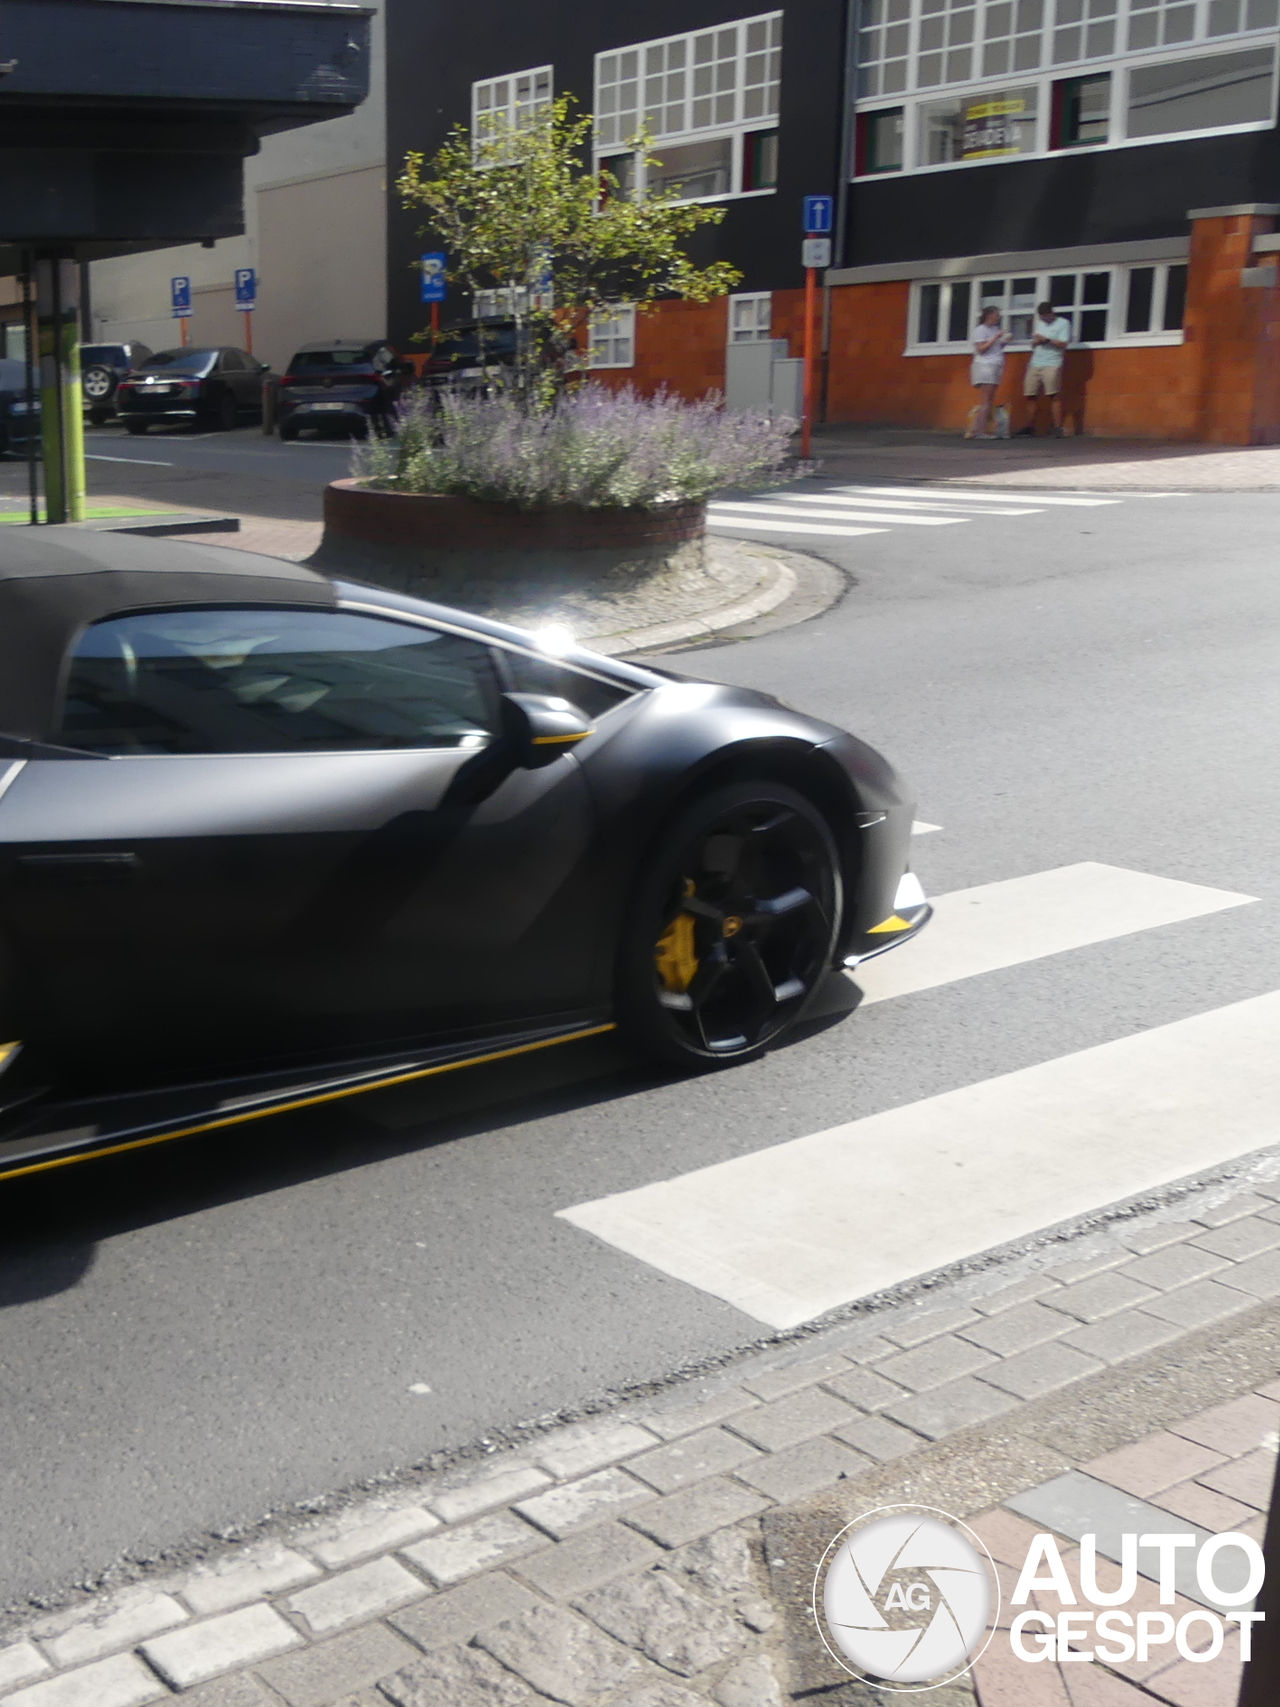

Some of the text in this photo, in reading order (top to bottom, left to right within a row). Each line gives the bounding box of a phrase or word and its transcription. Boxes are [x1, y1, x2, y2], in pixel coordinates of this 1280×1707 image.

[238, 270, 251, 288] P
[424, 259, 442, 284] P
[174, 279, 187, 295] P
